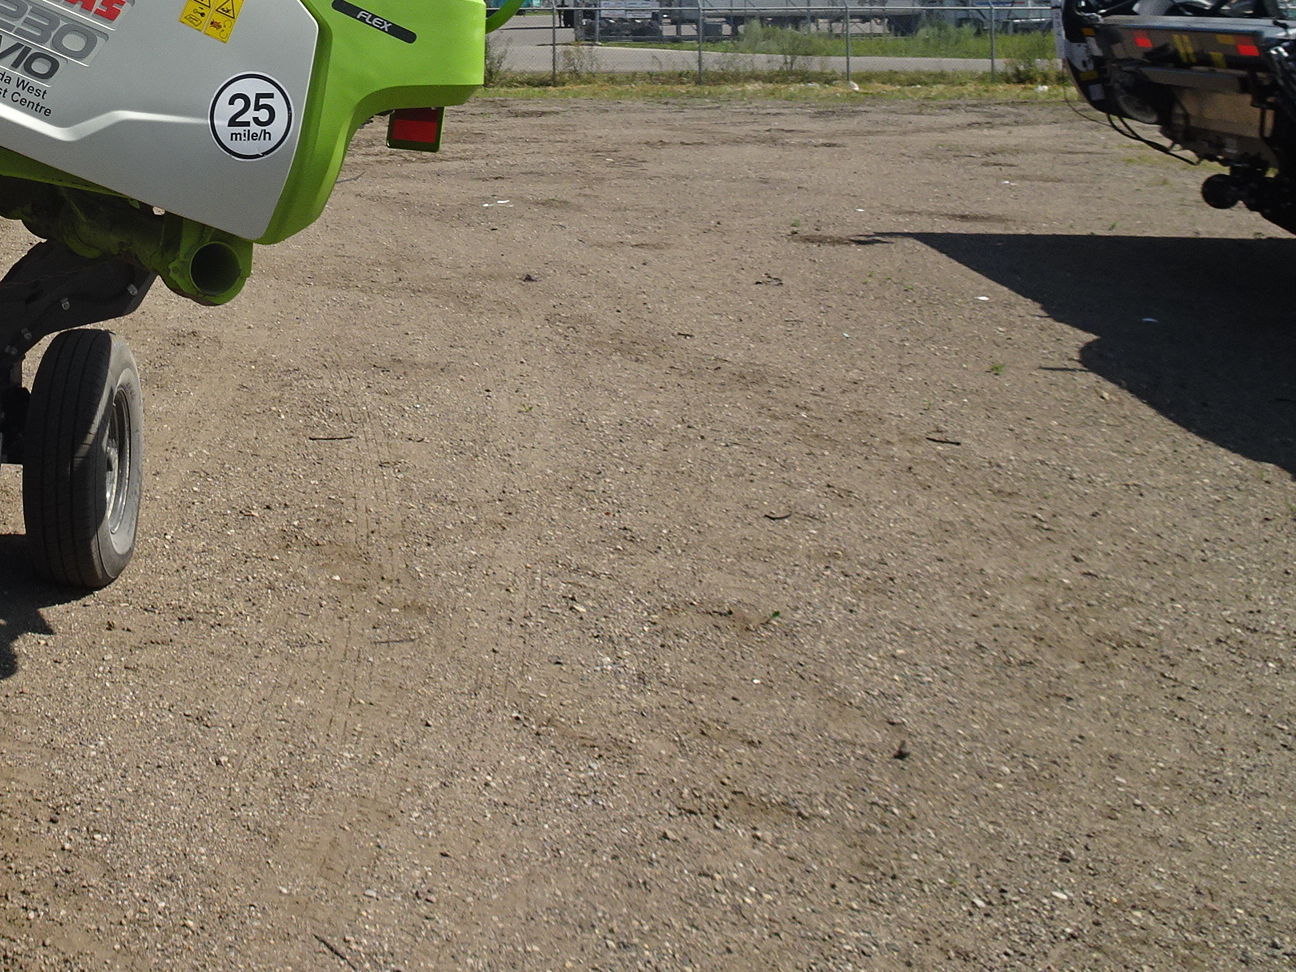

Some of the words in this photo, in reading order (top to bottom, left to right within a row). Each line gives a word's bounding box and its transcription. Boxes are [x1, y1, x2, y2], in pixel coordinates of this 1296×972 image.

[356, 10, 393, 32] FLEX
[15, 77, 48, 100] West
[11, 92, 52, 117] Centre
[227, 92, 276, 128] 25
[230, 129, 272, 142] mile/h
